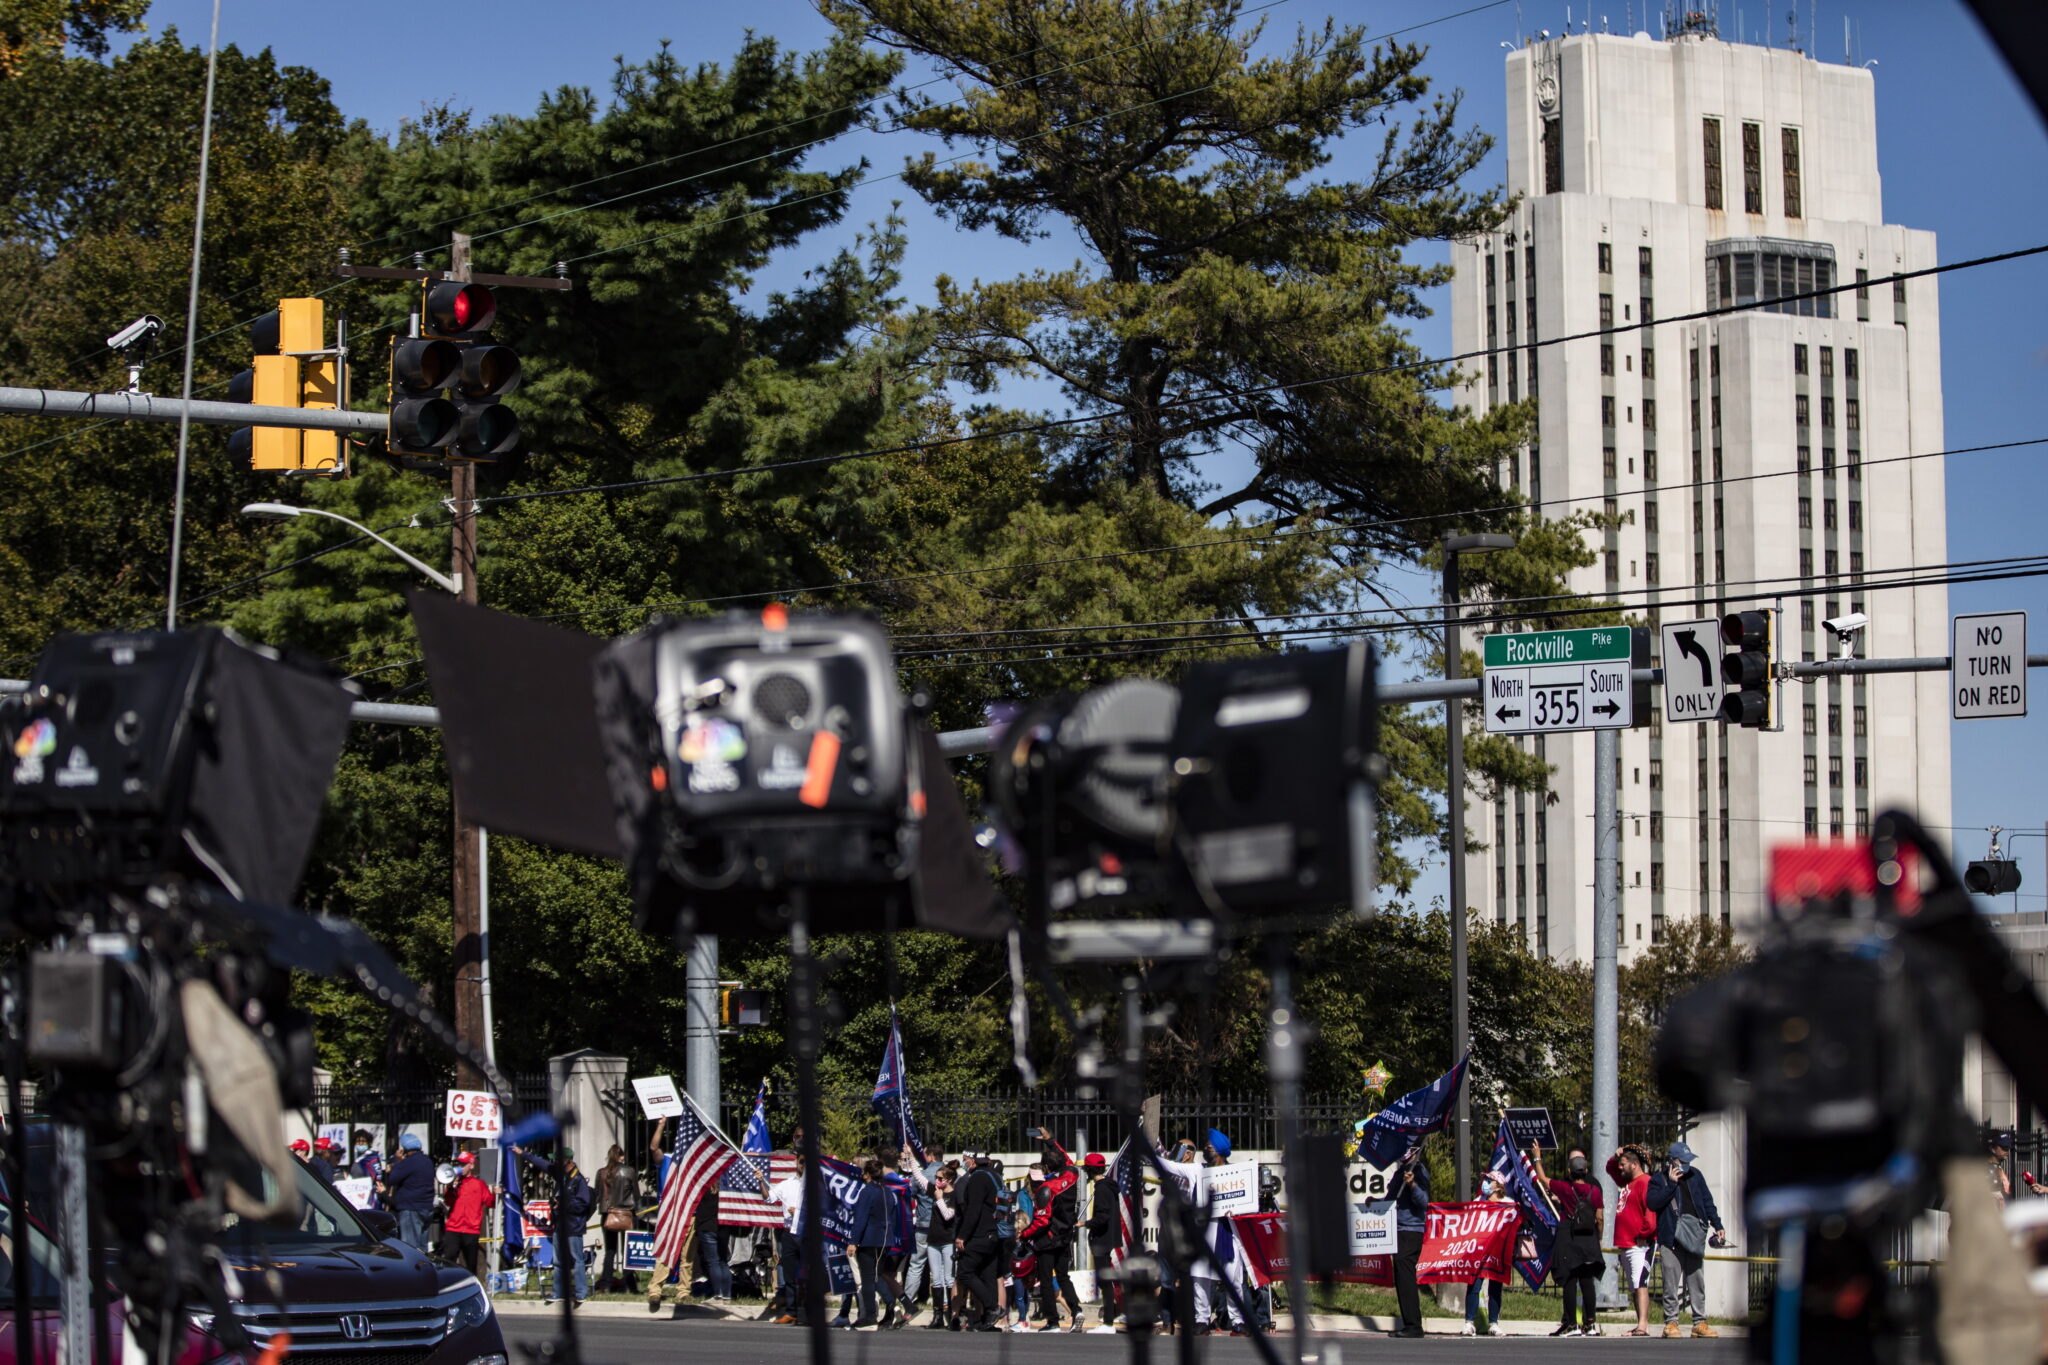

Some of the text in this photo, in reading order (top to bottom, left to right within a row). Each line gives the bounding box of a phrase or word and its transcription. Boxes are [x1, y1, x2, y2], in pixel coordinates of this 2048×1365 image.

[1977, 626, 2003, 646] NO
[1506, 632, 1612, 662] Rockville Pike
[1968, 655, 2011, 676] TURN
[1675, 692, 1716, 713] ONLY
[1959, 684, 2021, 707] ON RED
[1534, 689, 1580, 726] 355
[452, 1093, 500, 1117] GET
[449, 1117, 498, 1131] WELL
[1510, 1120, 1548, 1129] TRUMP
[820, 1165, 867, 1205] TRU
[1209, 1178, 1246, 1193] SIKHS
[1223, 1191, 1245, 1199] TRUMP
[1355, 1218, 1387, 1231] SIKHS
[1427, 1208, 1518, 1240] TRUMP
[1356, 1231, 1368, 1239] FOR
[628, 1240, 654, 1251] TRU
[1269, 1258, 1291, 1268] KEE
[1354, 1258, 1382, 1270] REAT!
[1432, 1258, 1472, 1269] AMERICA
